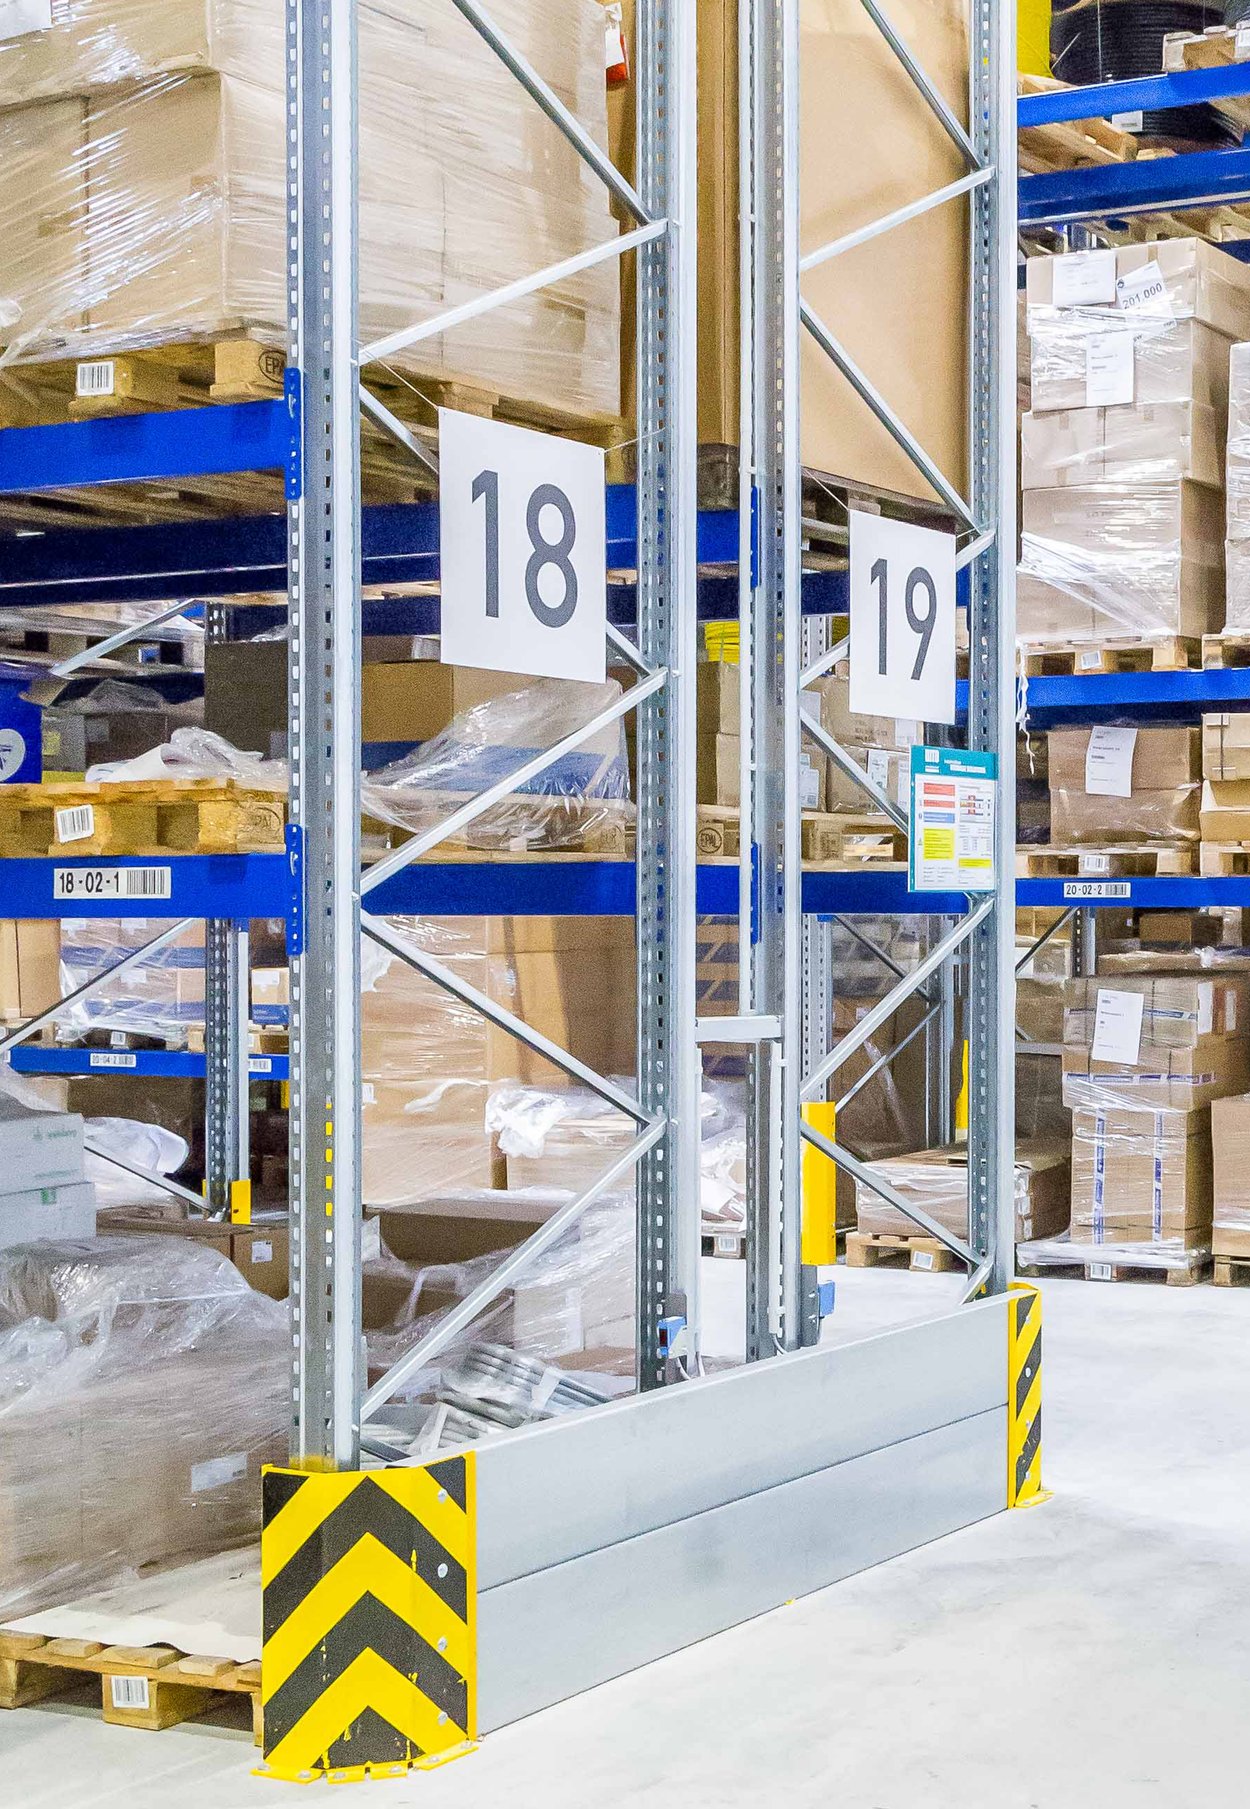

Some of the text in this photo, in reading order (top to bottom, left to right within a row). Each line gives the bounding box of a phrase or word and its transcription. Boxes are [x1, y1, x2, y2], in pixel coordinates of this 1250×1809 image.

[471, 469, 578, 629] 18
[870, 558, 937, 681] 19
[60, 871, 119, 893] 18-02-1
[1066, 884, 1103, 896] 20-02-2
